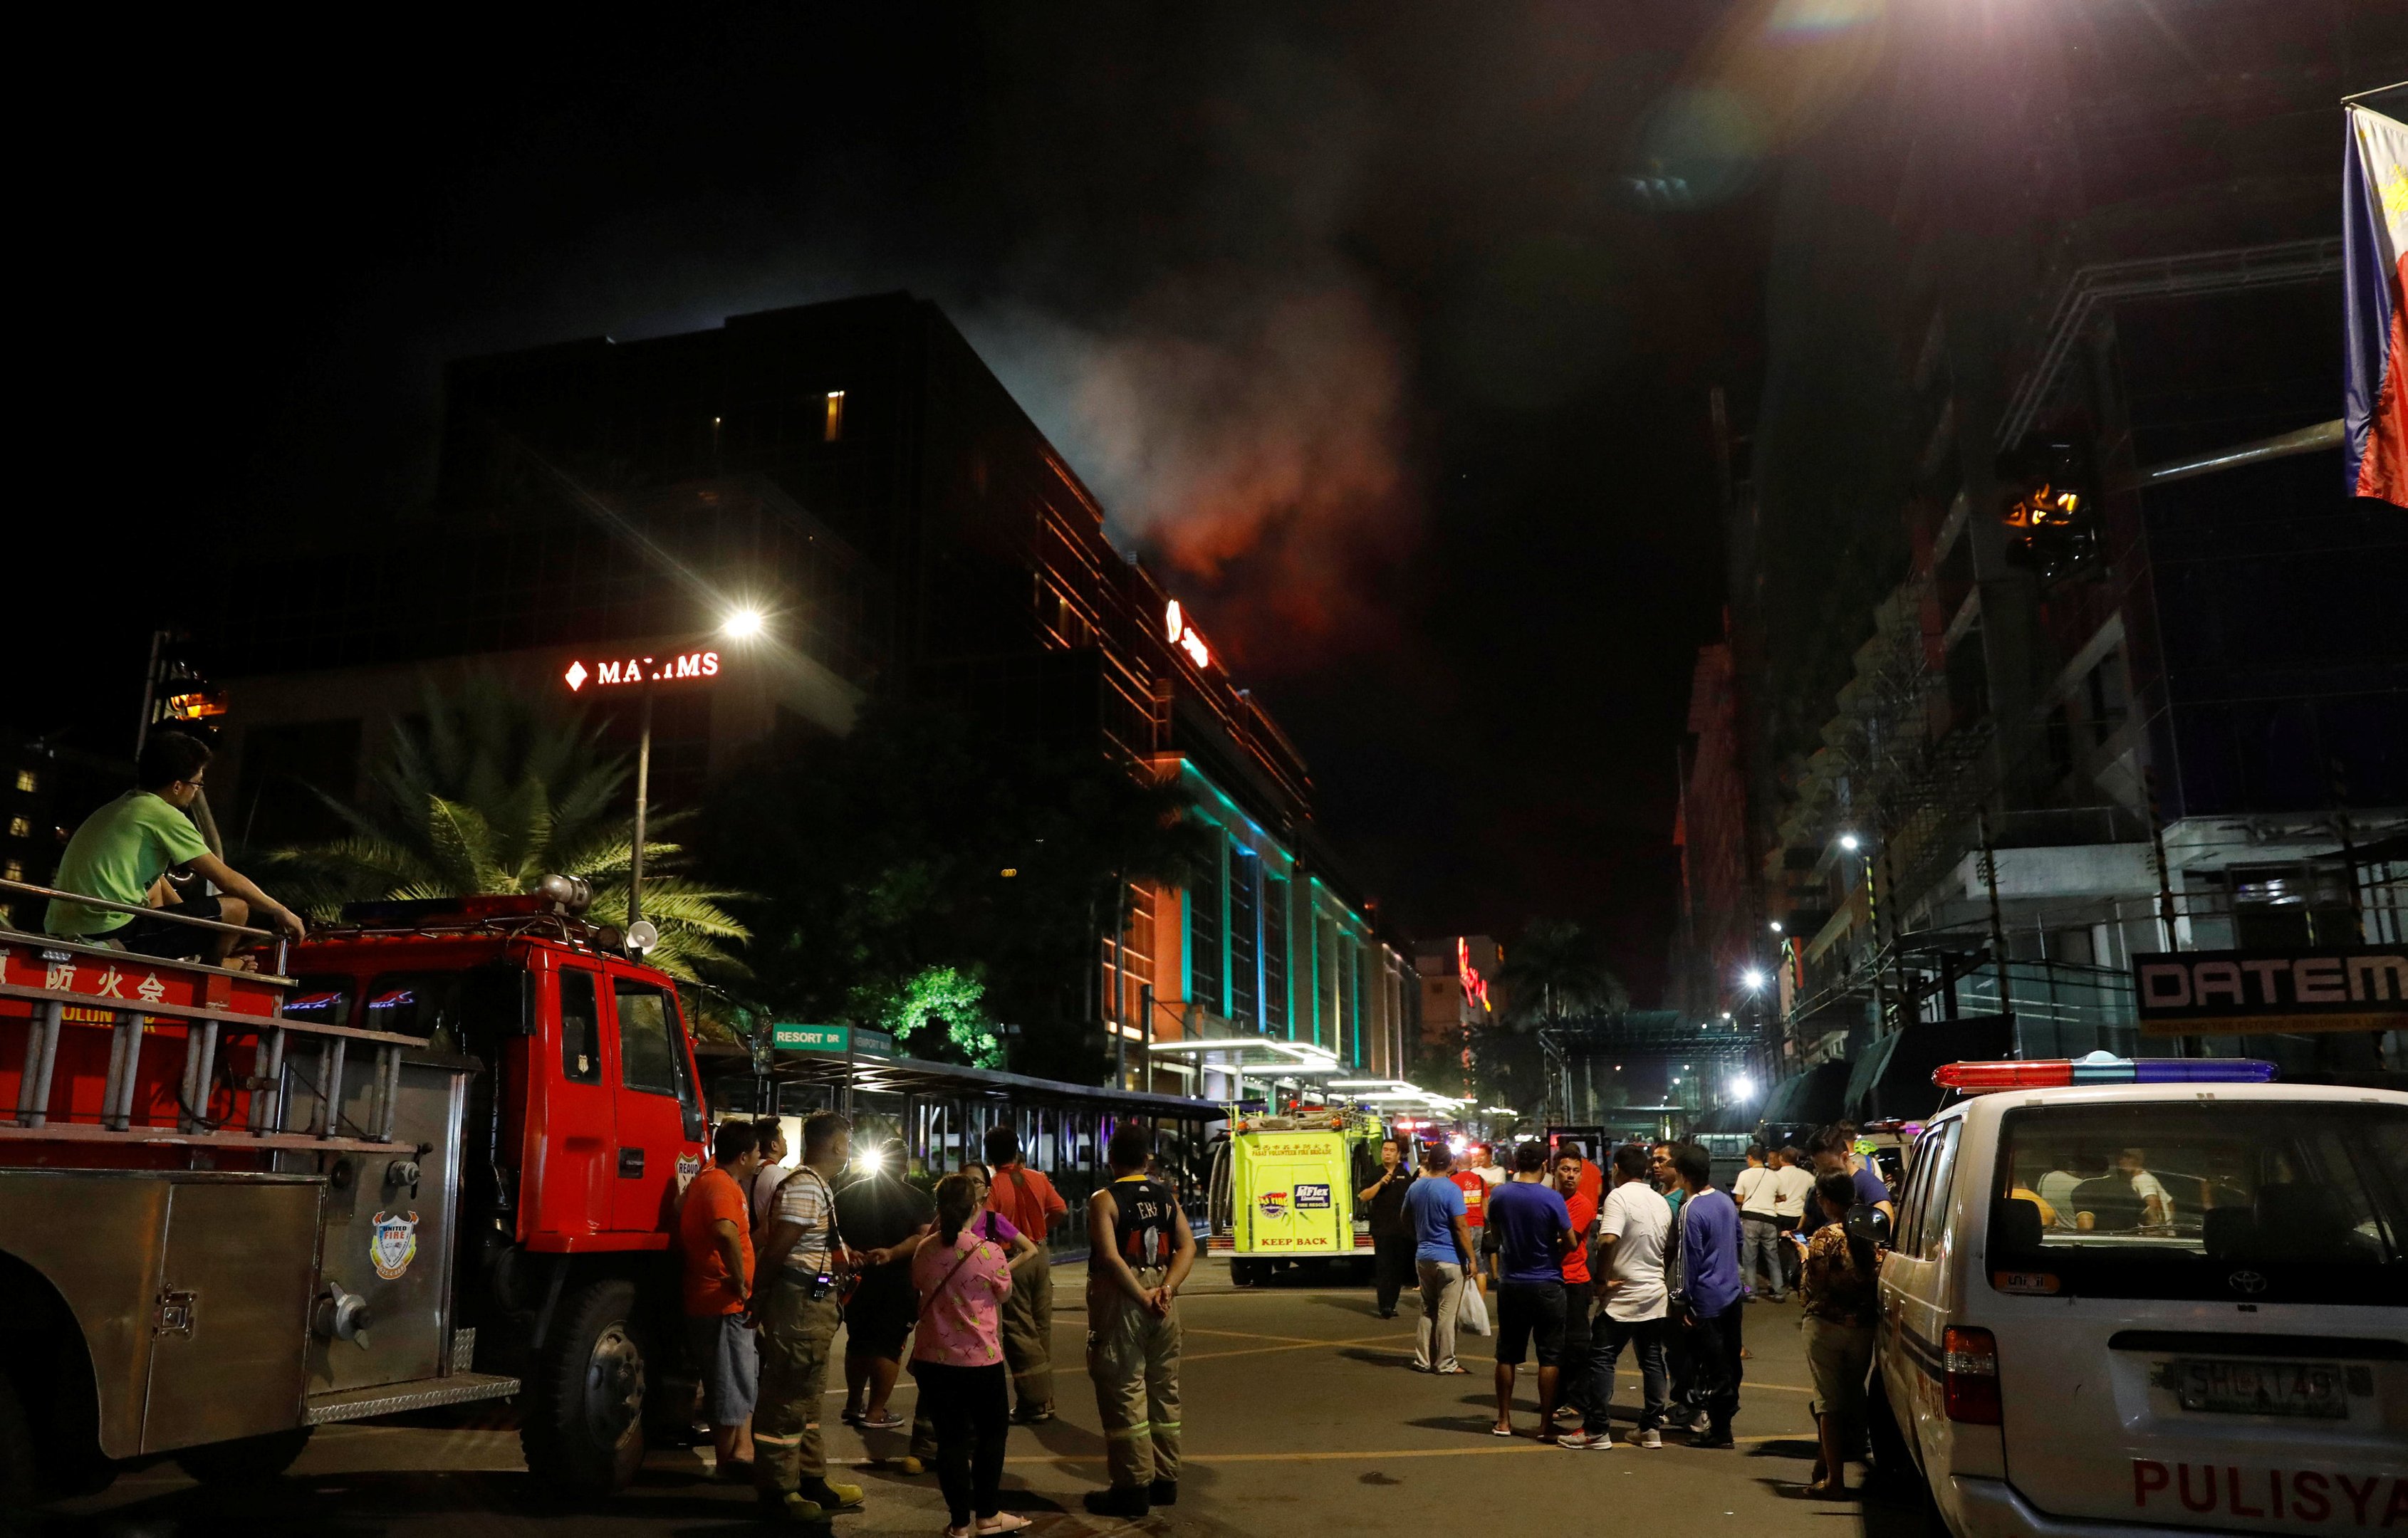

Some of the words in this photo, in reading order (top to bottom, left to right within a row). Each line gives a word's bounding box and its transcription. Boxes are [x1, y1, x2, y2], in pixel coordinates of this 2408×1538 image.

[598, 652, 718, 684] MAIMS
[776, 1032, 823, 1043] RESORT
[827, 1034, 839, 1042] DR
[2008, 1275, 2043, 1287] Uniil
